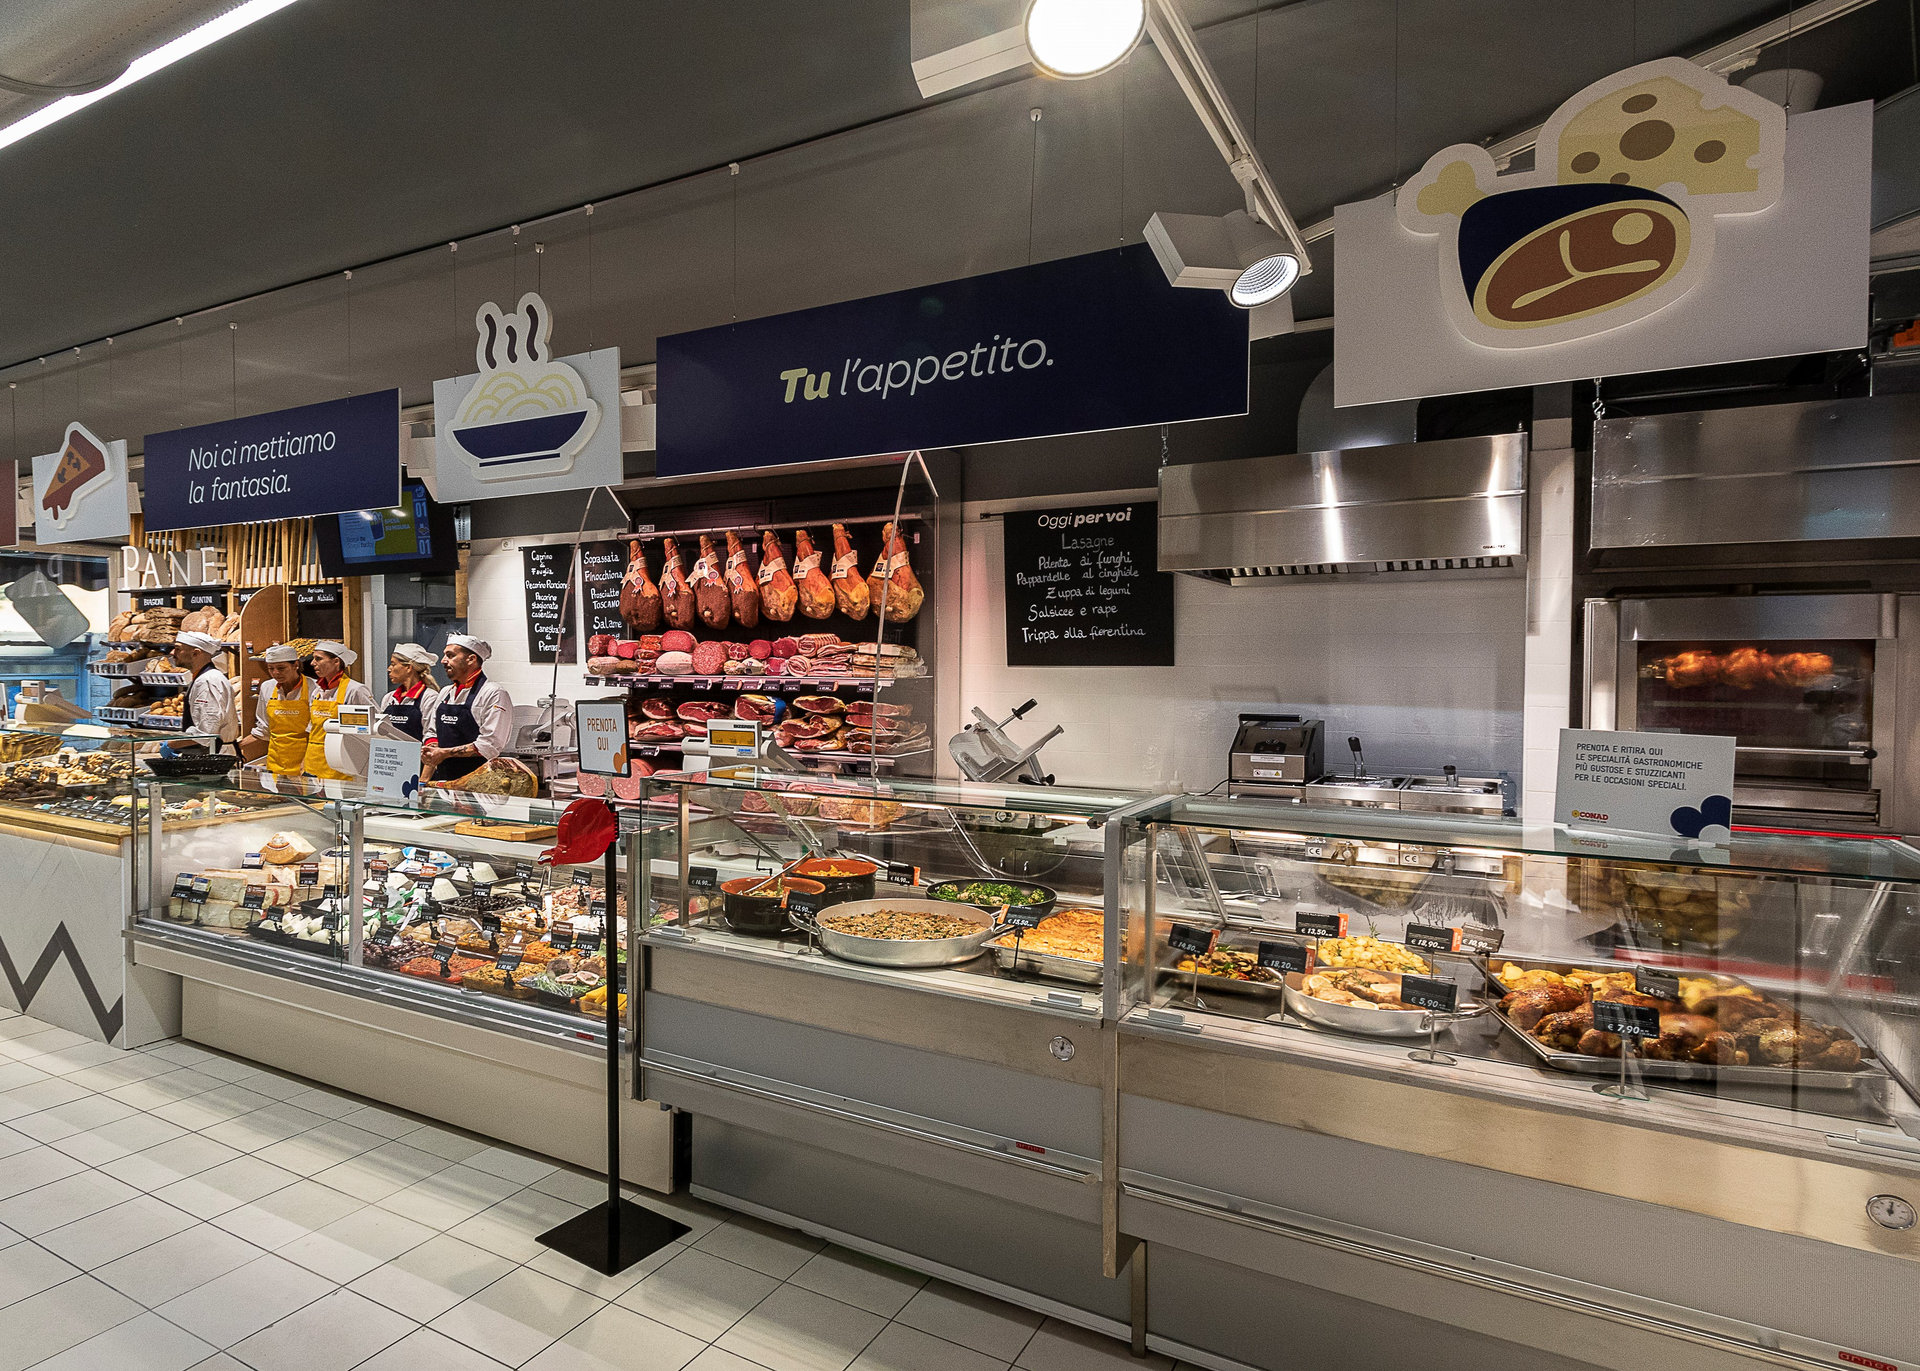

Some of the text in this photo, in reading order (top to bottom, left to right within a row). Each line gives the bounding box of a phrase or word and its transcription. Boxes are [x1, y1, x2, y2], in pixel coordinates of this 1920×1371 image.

[780, 367, 831, 403] Tu
[188, 431, 336, 472] Noi ci mettiamo
[188, 469, 292, 504] la fantasia.
[416, 502, 427, 517] 01
[1038, 507, 1132, 529] Oggi per voi
[420, 540, 431, 555] 01
[1062, 533, 1115, 552] Lasagne
[531, 551, 552, 562] Caprino
[1080, 553, 1092, 566] ai
[1096, 551, 1132, 569] funghi
[121, 546, 217, 590] PANE
[584, 570, 624, 582] Finocchiona
[1017, 565, 1139, 588] Pappardelle al cinghiale
[526, 580, 546, 589] Pecorino
[1046, 583, 1131, 600] Zuppa di legumi
[535, 592, 557, 601] Pecorino
[591, 588, 619, 599] Prosciutto
[1080, 607, 1088, 616] e
[1092, 605, 1118, 618] rape
[593, 616, 622, 629] Salame
[1022, 623, 1146, 643] Trippa alla fiorentina
[587, 718, 617, 732] PRENOTA
[597, 737, 609, 750] QUI
[1577, 743, 1610, 753] PRENOTA
[1621, 745, 1646, 755] RITIRA
[1649, 748, 1663, 756] QUI
[1588, 754, 1630, 764] SPECIALITÀ
[1634, 757, 1703, 770] GASTRONOMICHE
[1575, 762, 1587, 771] PIÙ
[1590, 765, 1624, 774] GUSTOSE
[1635, 768, 1686, 779] STUZZICANTI
[1574, 774, 1687, 791] PER LE OCCASIONI SPECIALI.
[1579, 811, 1609, 821] CONAD
[1419, 998, 1438, 1007] 5,90
[1617, 1024, 1640, 1034] 7,90
